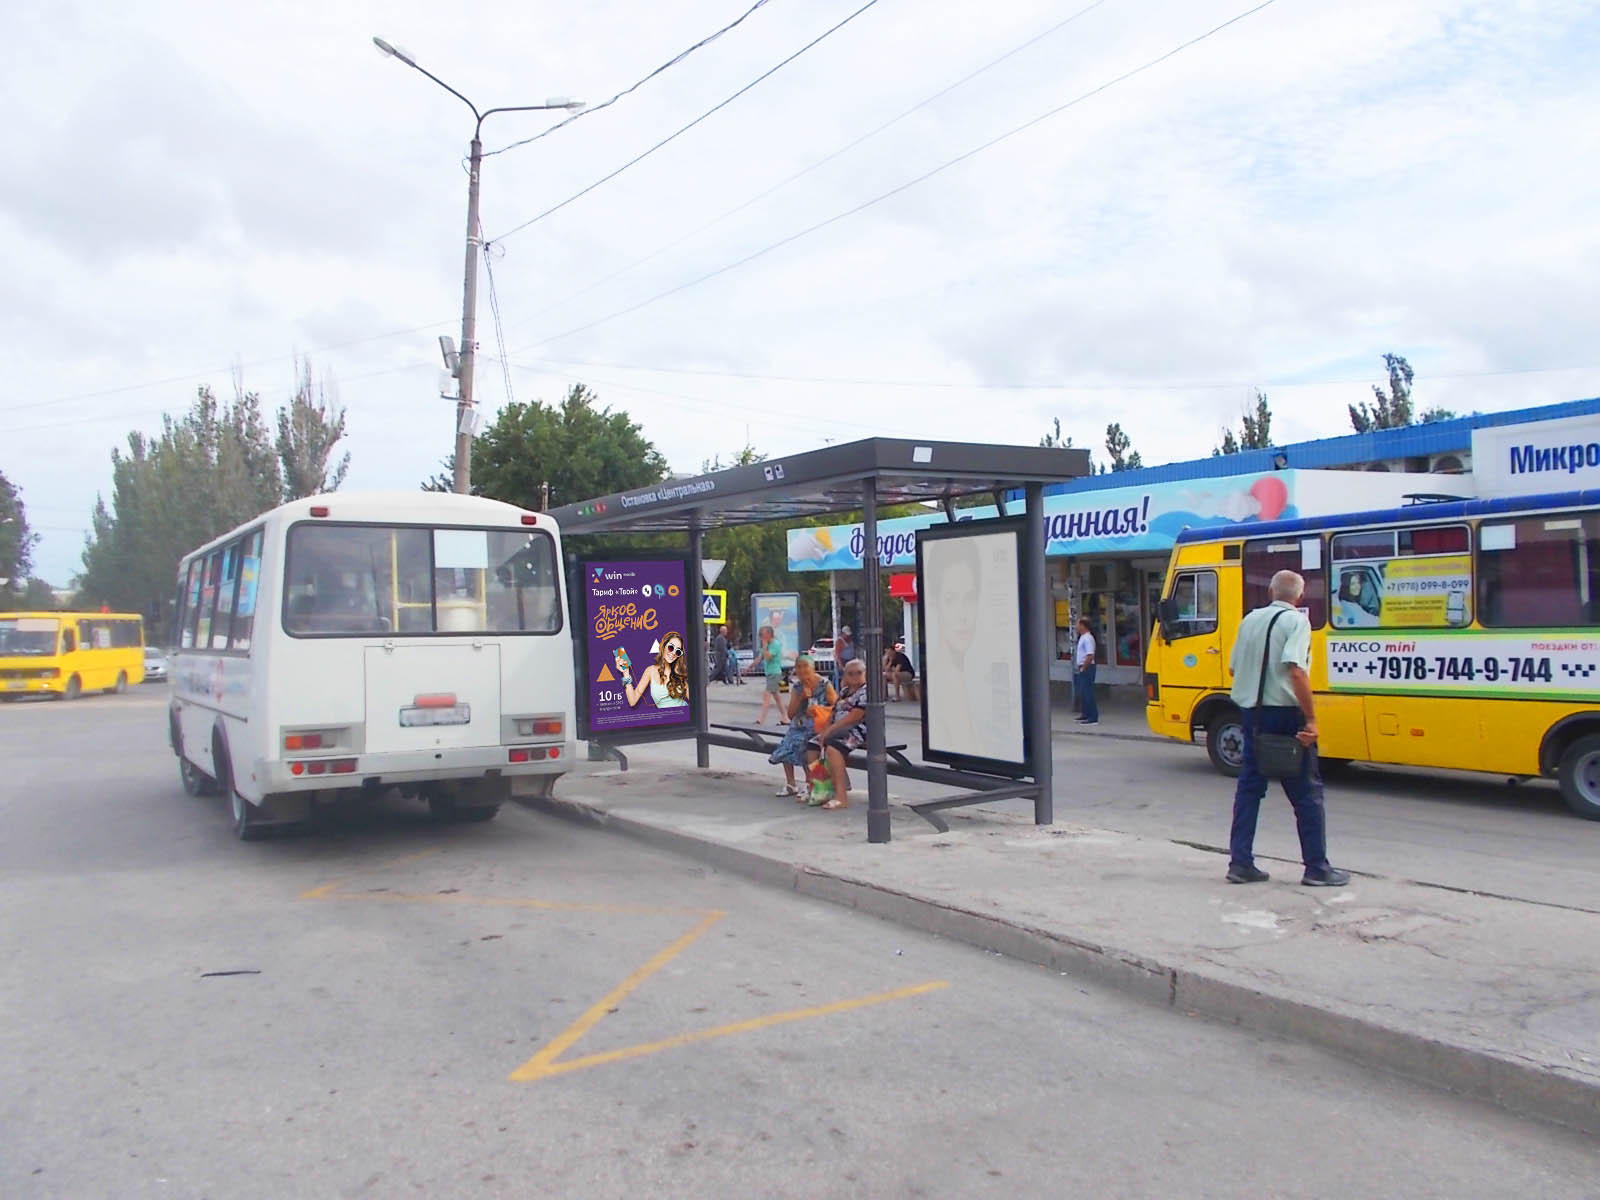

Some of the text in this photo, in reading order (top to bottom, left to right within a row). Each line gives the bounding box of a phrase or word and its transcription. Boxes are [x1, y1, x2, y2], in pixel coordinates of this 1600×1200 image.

[1510, 443, 1600, 474] Микро
[620, 479, 716, 508] Остановка «Центральная»
[850, 527, 915, 565] Фодос
[605, 570, 623, 580] win
[1420, 579, 1470, 591] 099-8-099
[592, 587, 639, 597] Тариф «Твой»
[1330, 641, 1417, 654] ТАКСО mini
[1365, 656, 1553, 683] +7978-744-9-744
[598, 690, 612, 702] 10
